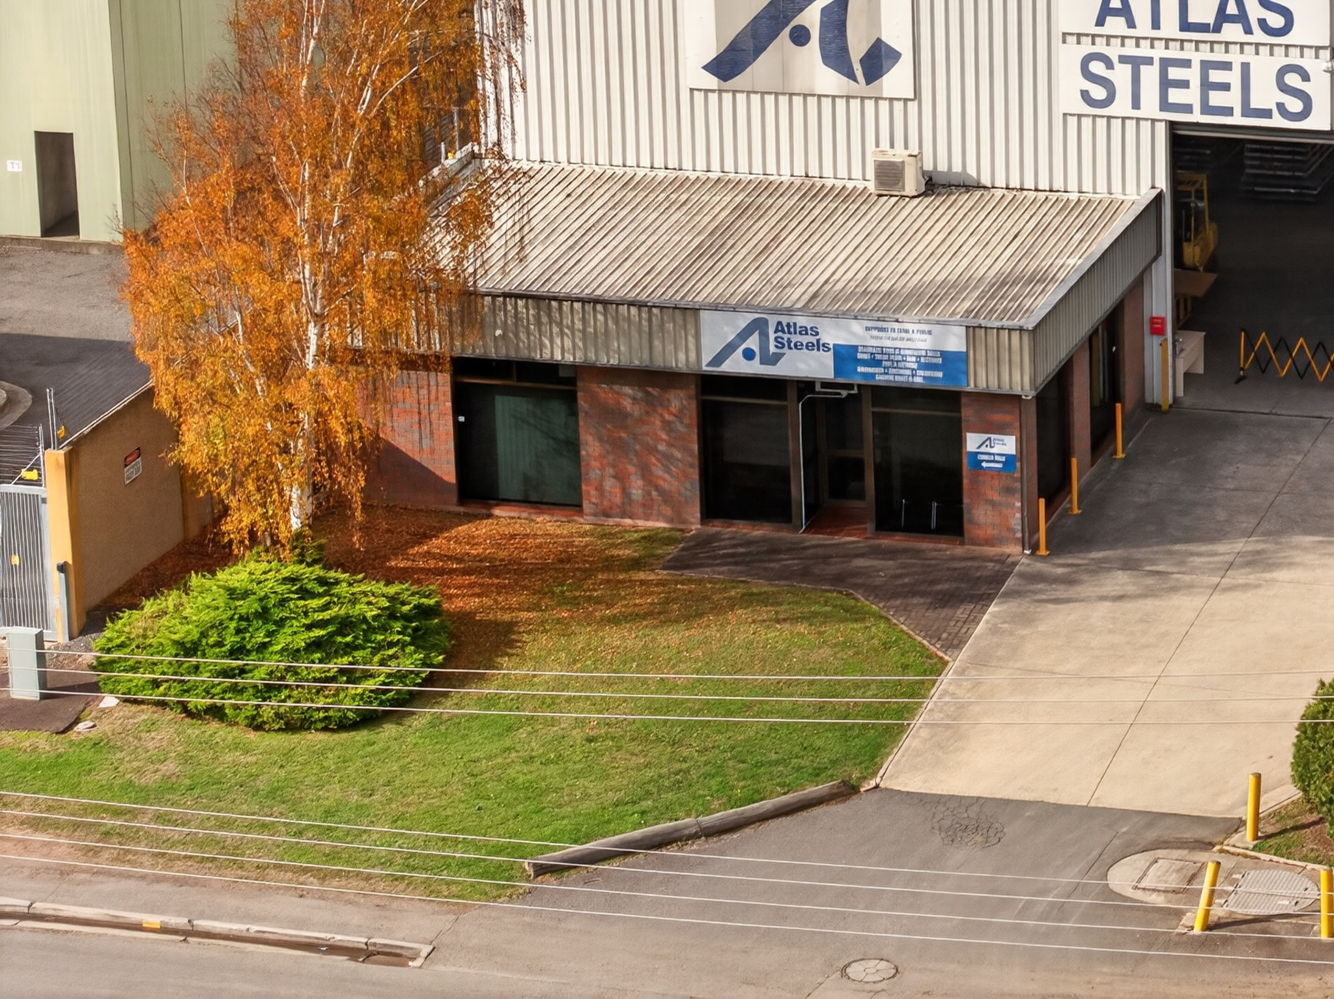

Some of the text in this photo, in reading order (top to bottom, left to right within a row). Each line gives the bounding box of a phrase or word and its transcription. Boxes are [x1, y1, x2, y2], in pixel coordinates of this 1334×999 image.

[1079, 52, 1313, 123] STEELS
[773, 320, 820, 337] Atlas
[773, 335, 832, 353] Steels
